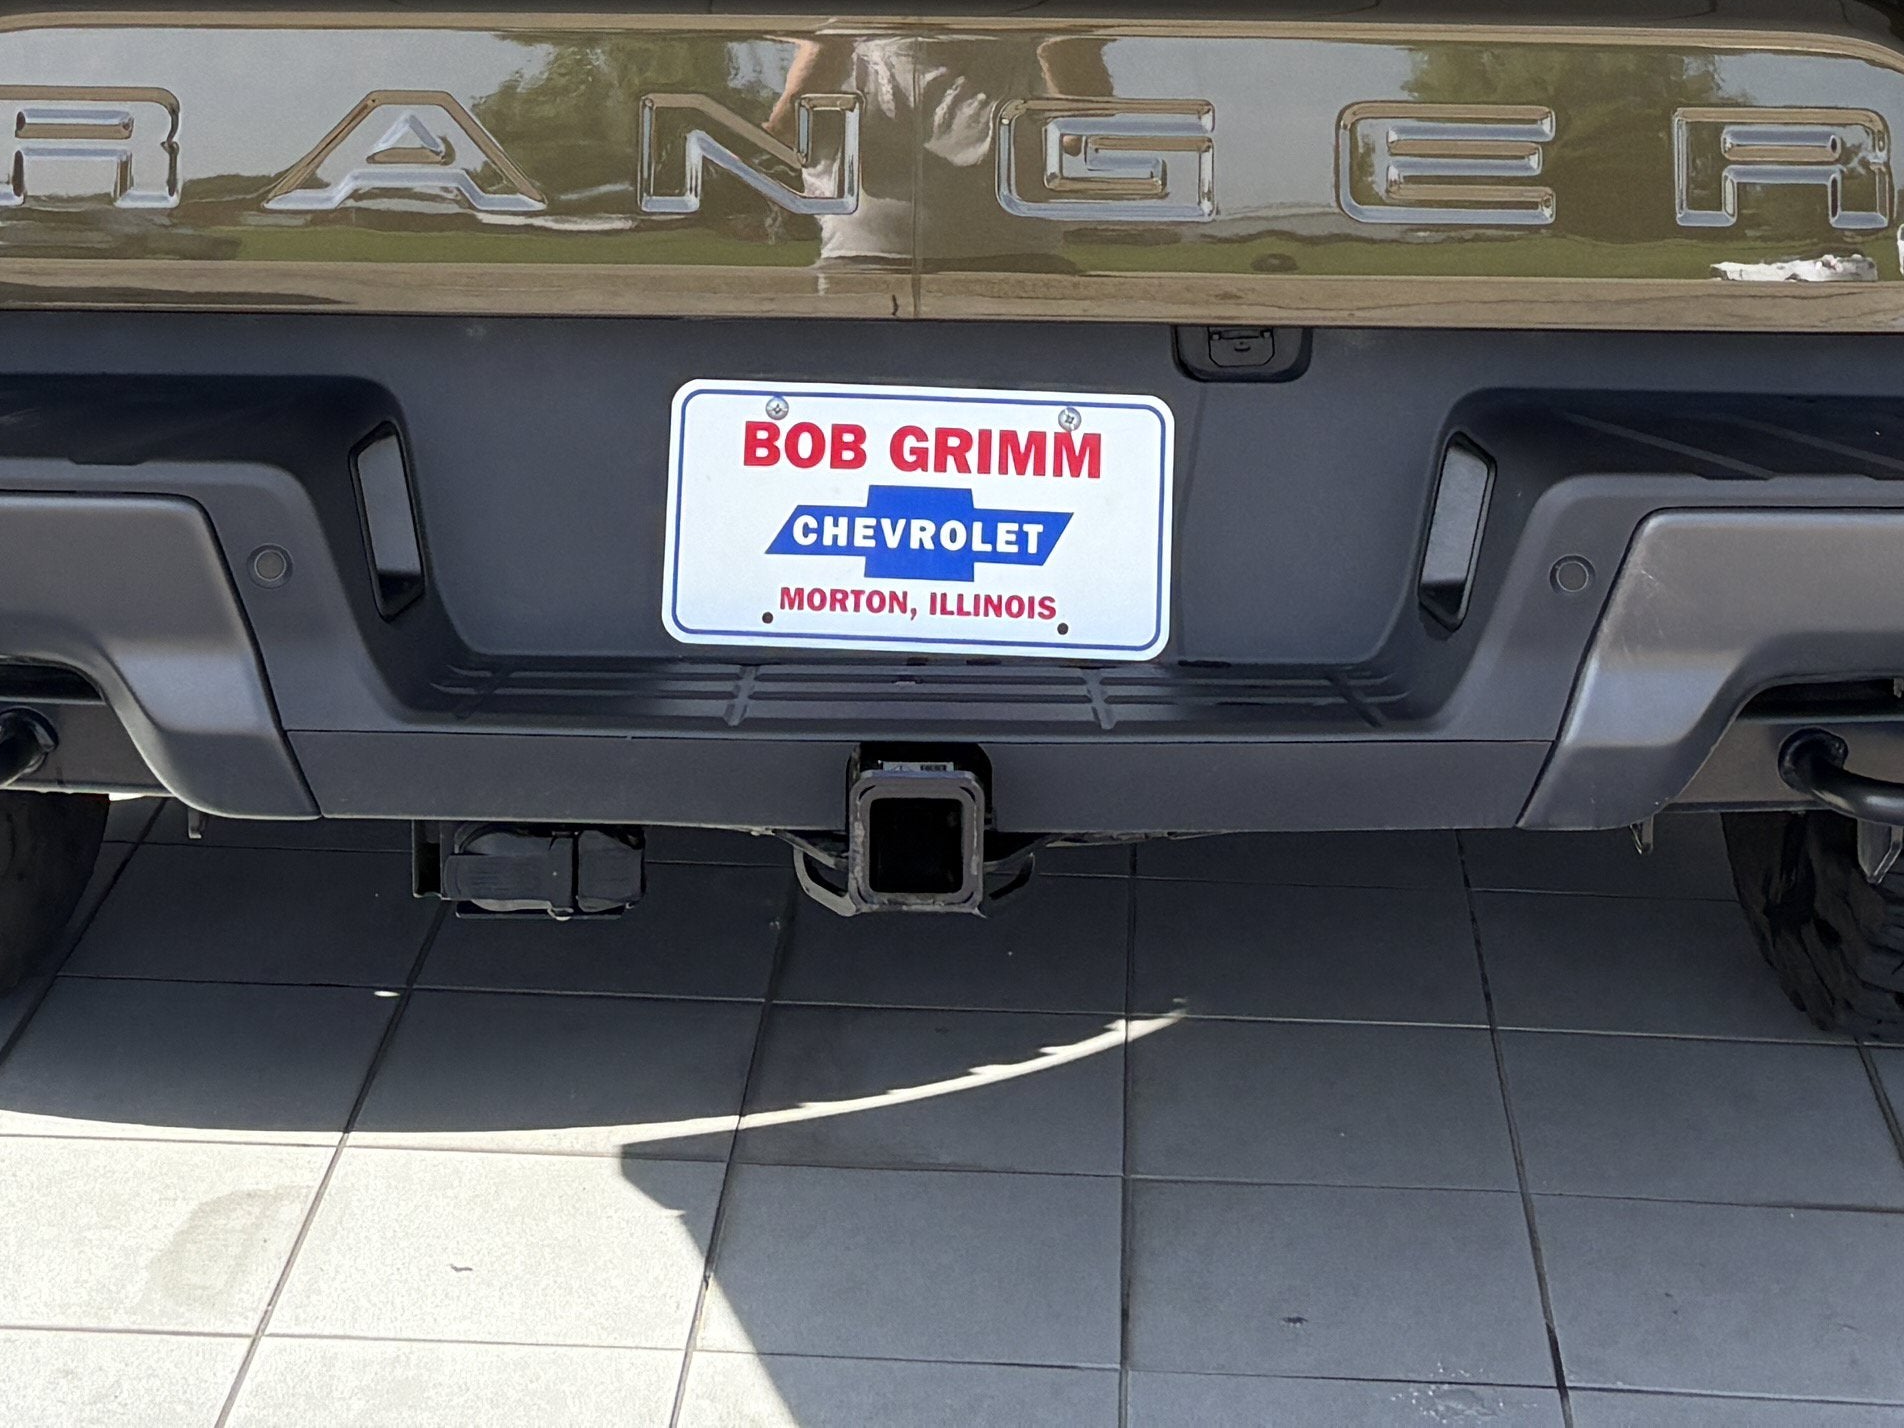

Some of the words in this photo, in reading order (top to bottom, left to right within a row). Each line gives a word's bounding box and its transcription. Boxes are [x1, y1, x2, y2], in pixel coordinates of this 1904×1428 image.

[743, 420, 867, 470] BOB
[889, 425, 1102, 479] GRIMM
[792, 514, 1044, 555] CHEVROLET
[779, 586, 918, 621] MORTON,
[929, 592, 1057, 621] ILLINOIS
